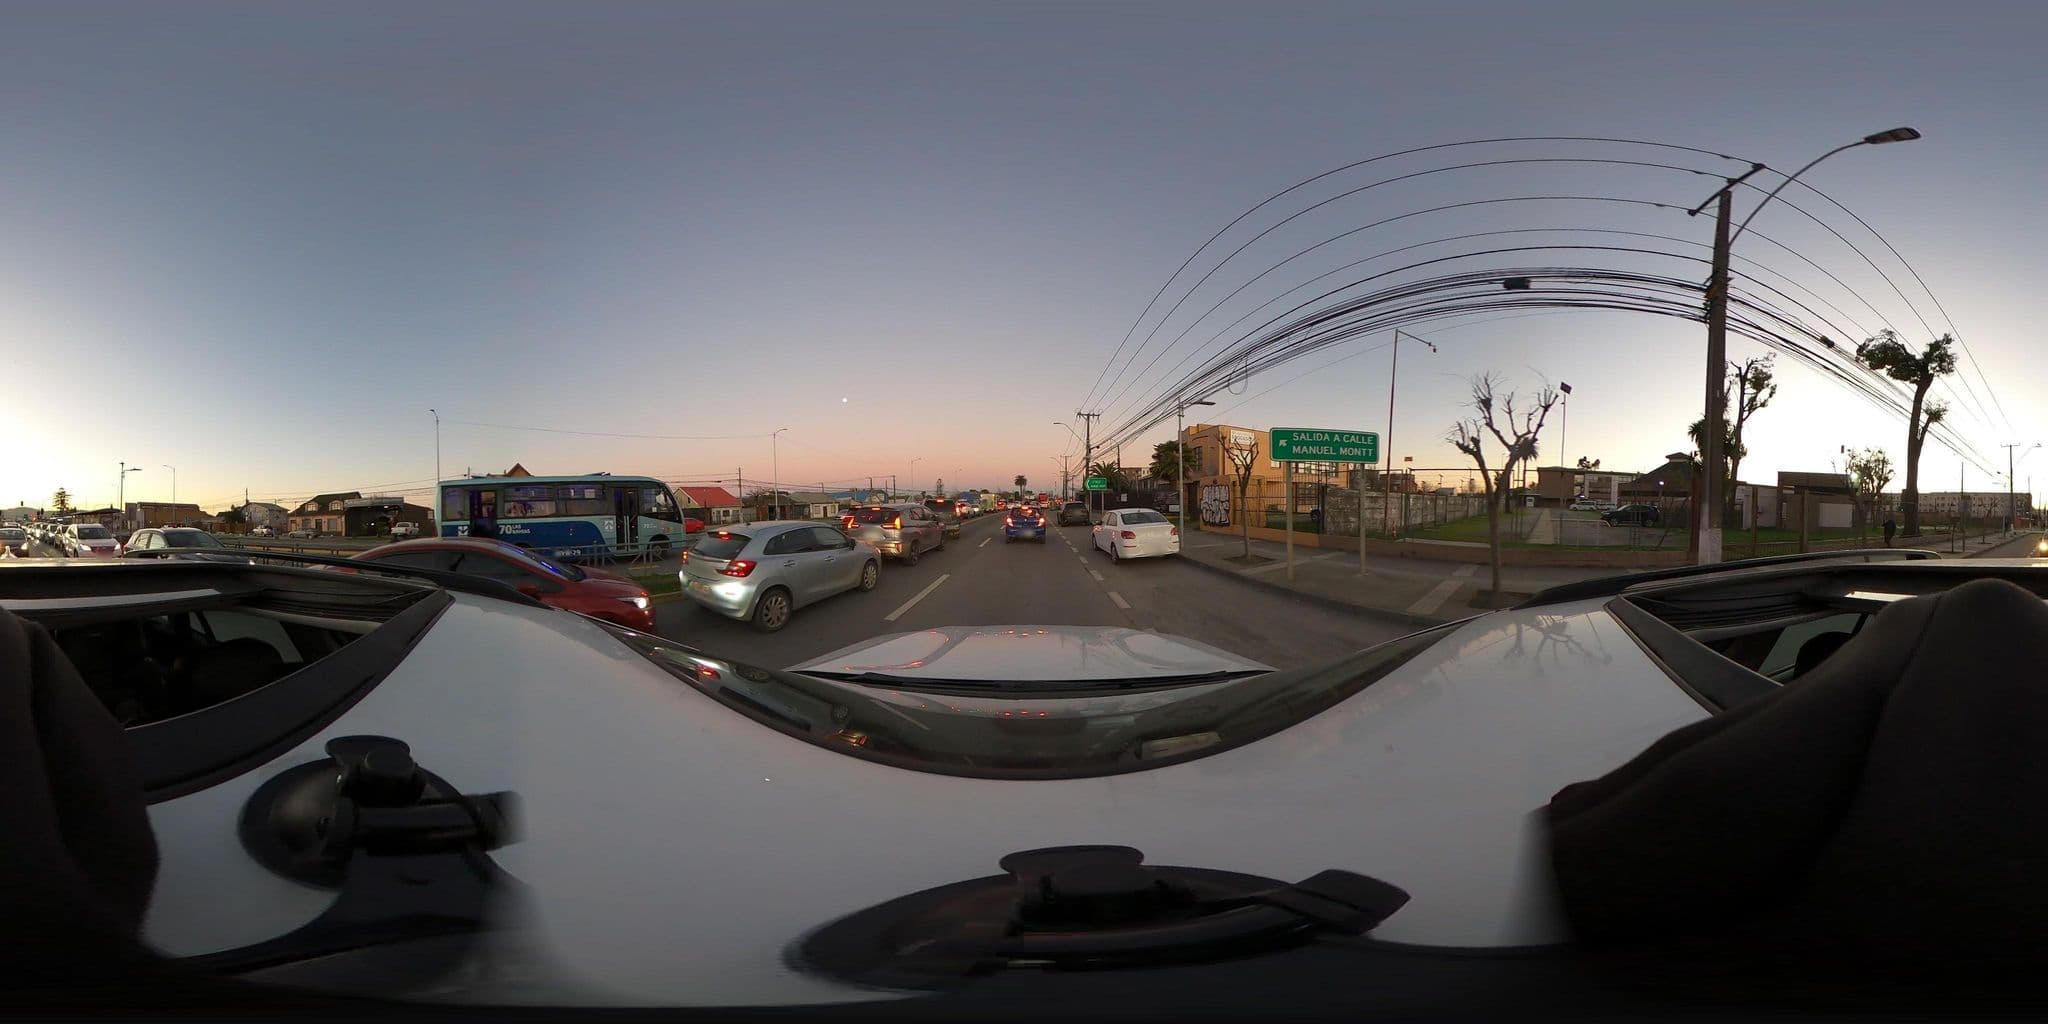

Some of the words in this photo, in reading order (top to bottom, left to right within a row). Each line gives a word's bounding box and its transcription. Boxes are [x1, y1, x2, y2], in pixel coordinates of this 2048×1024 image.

[1292, 432, 1330, 442] SALIDA
[1333, 433, 1341, 442] A
[1343, 434, 1374, 445] CALLE
[1292, 445, 1337, 455] MANUEL
[1340, 447, 1374, 457] MONTT
[498, 524, 512, 535] 70
